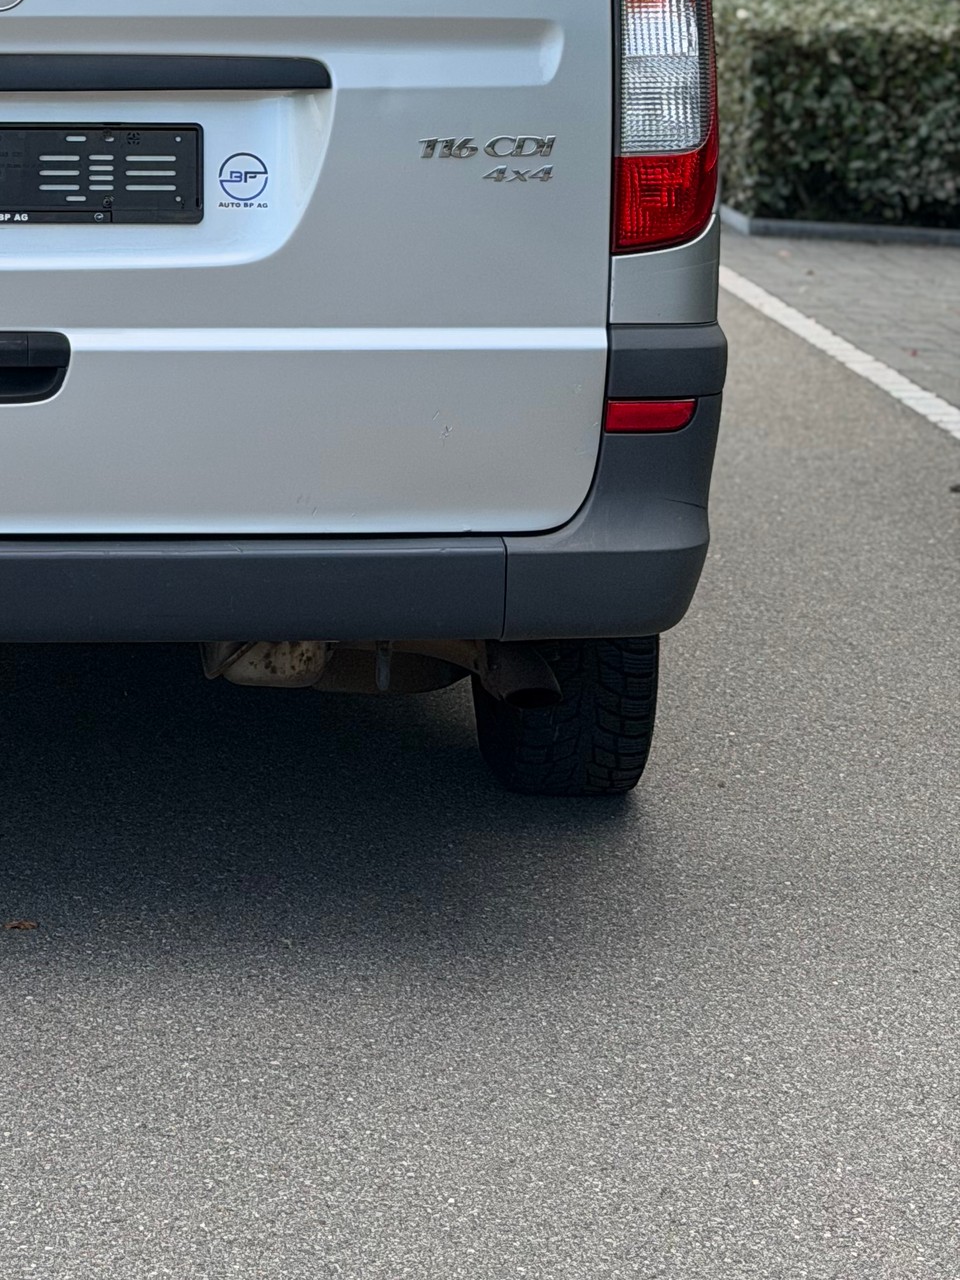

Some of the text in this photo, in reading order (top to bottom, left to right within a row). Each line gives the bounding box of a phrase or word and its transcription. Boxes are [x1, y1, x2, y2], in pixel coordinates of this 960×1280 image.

[419, 135, 556, 158] 116 CDI
[482, 164, 554, 182] 4x4
[14, 213, 29, 221] AG
